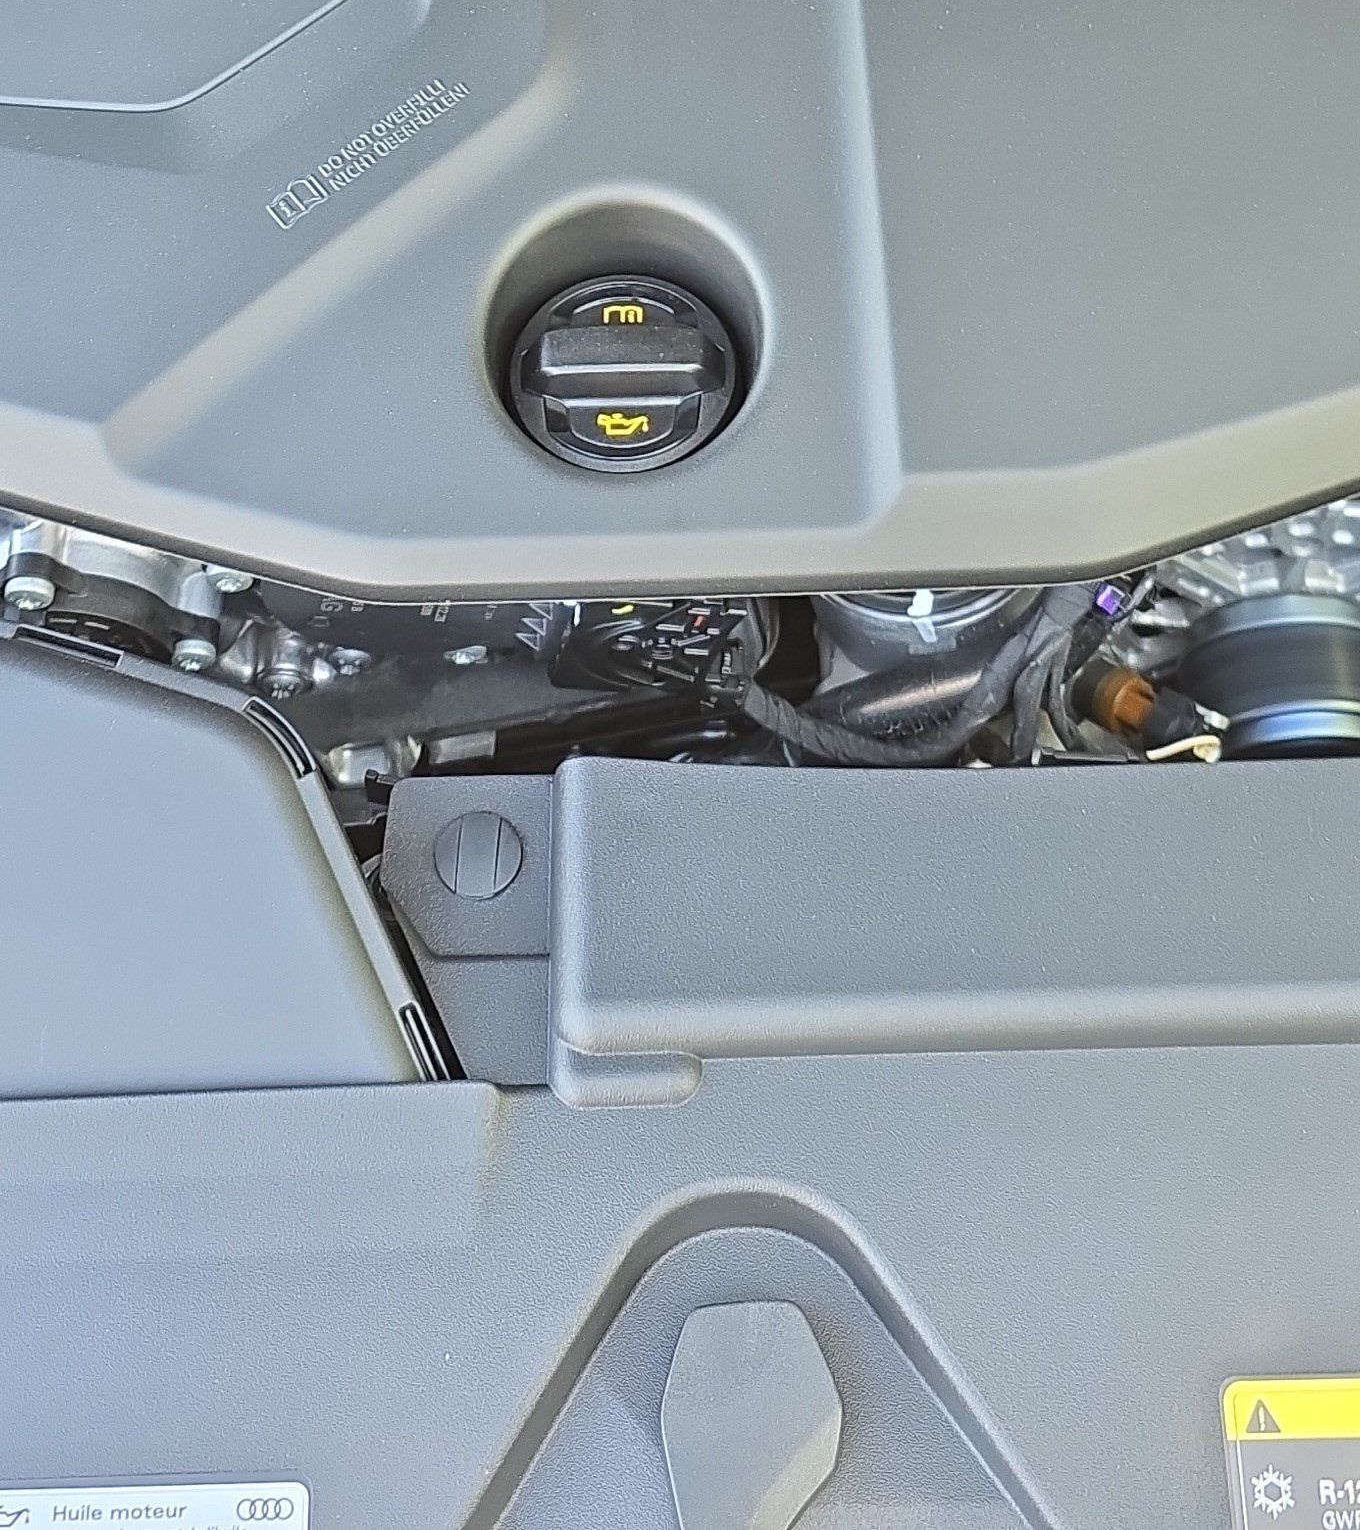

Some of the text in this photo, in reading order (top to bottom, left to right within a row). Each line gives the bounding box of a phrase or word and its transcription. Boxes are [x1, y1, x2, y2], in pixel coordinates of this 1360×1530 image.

[318, 155, 344, 178] DO
[341, 131, 374, 162] NOT
[328, 152, 377, 191] NICHT
[52, 1503, 187, 1523] Huile moteur
